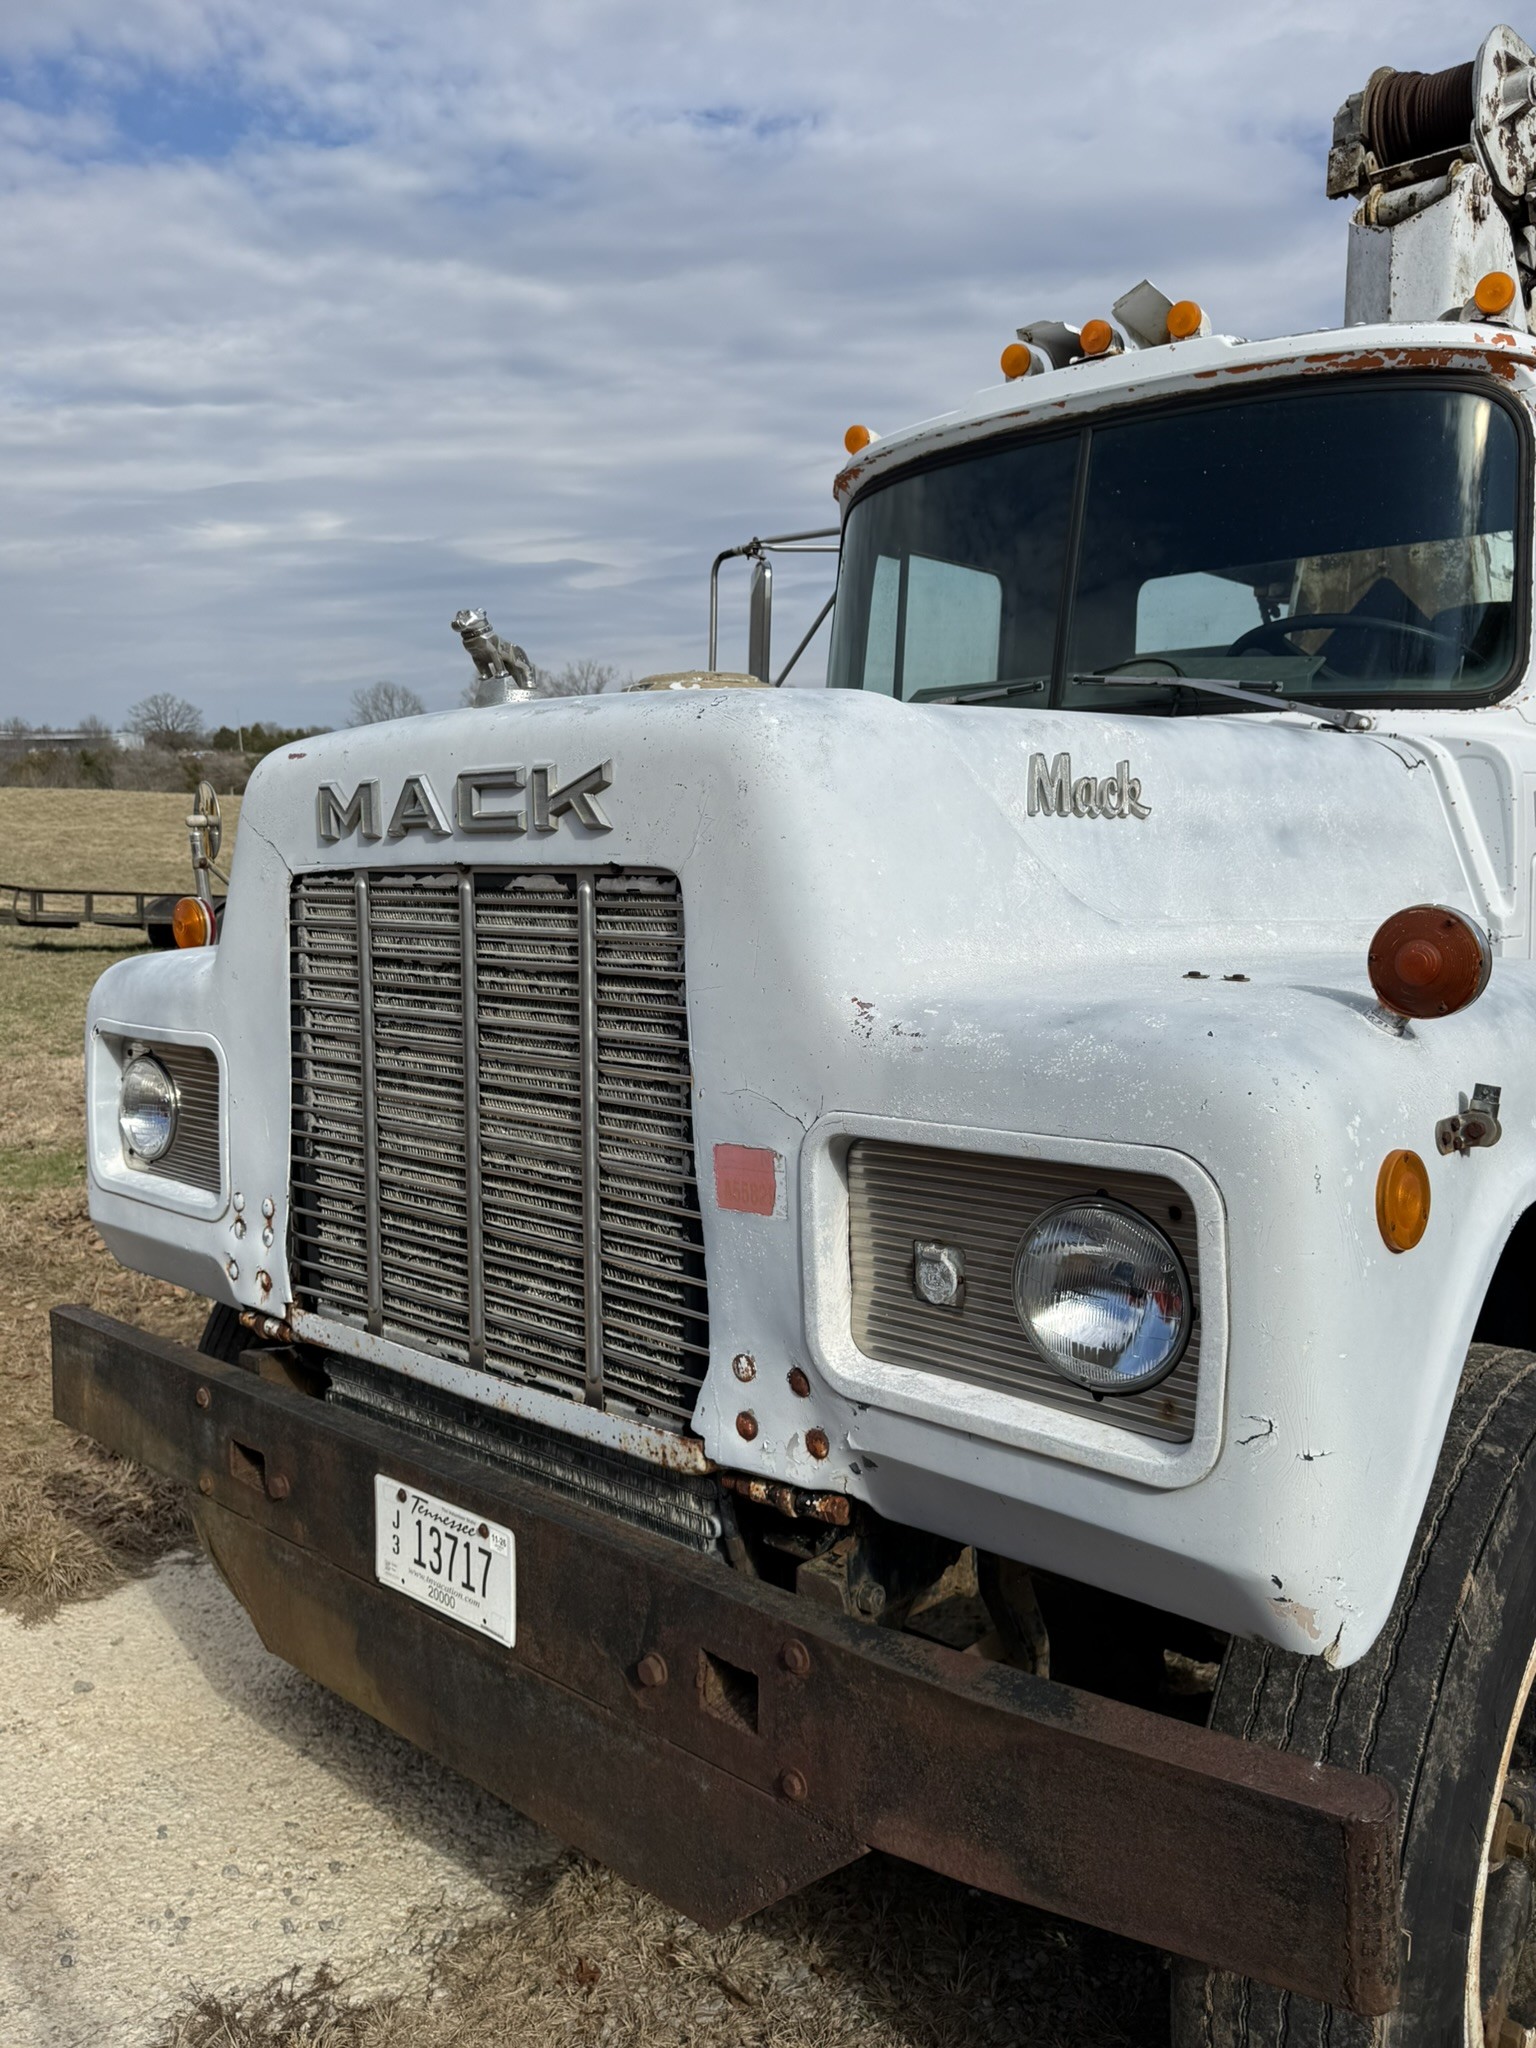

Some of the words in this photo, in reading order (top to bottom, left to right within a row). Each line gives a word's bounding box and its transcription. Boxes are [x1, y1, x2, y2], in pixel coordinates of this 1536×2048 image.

[317, 757, 614, 842] MACK
[1027, 752, 1152, 820] Mack
[411, 1494, 477, 1537] Tennessee
[413, 1519, 492, 1599] 13717
[428, 1585, 456, 1610] 20000
